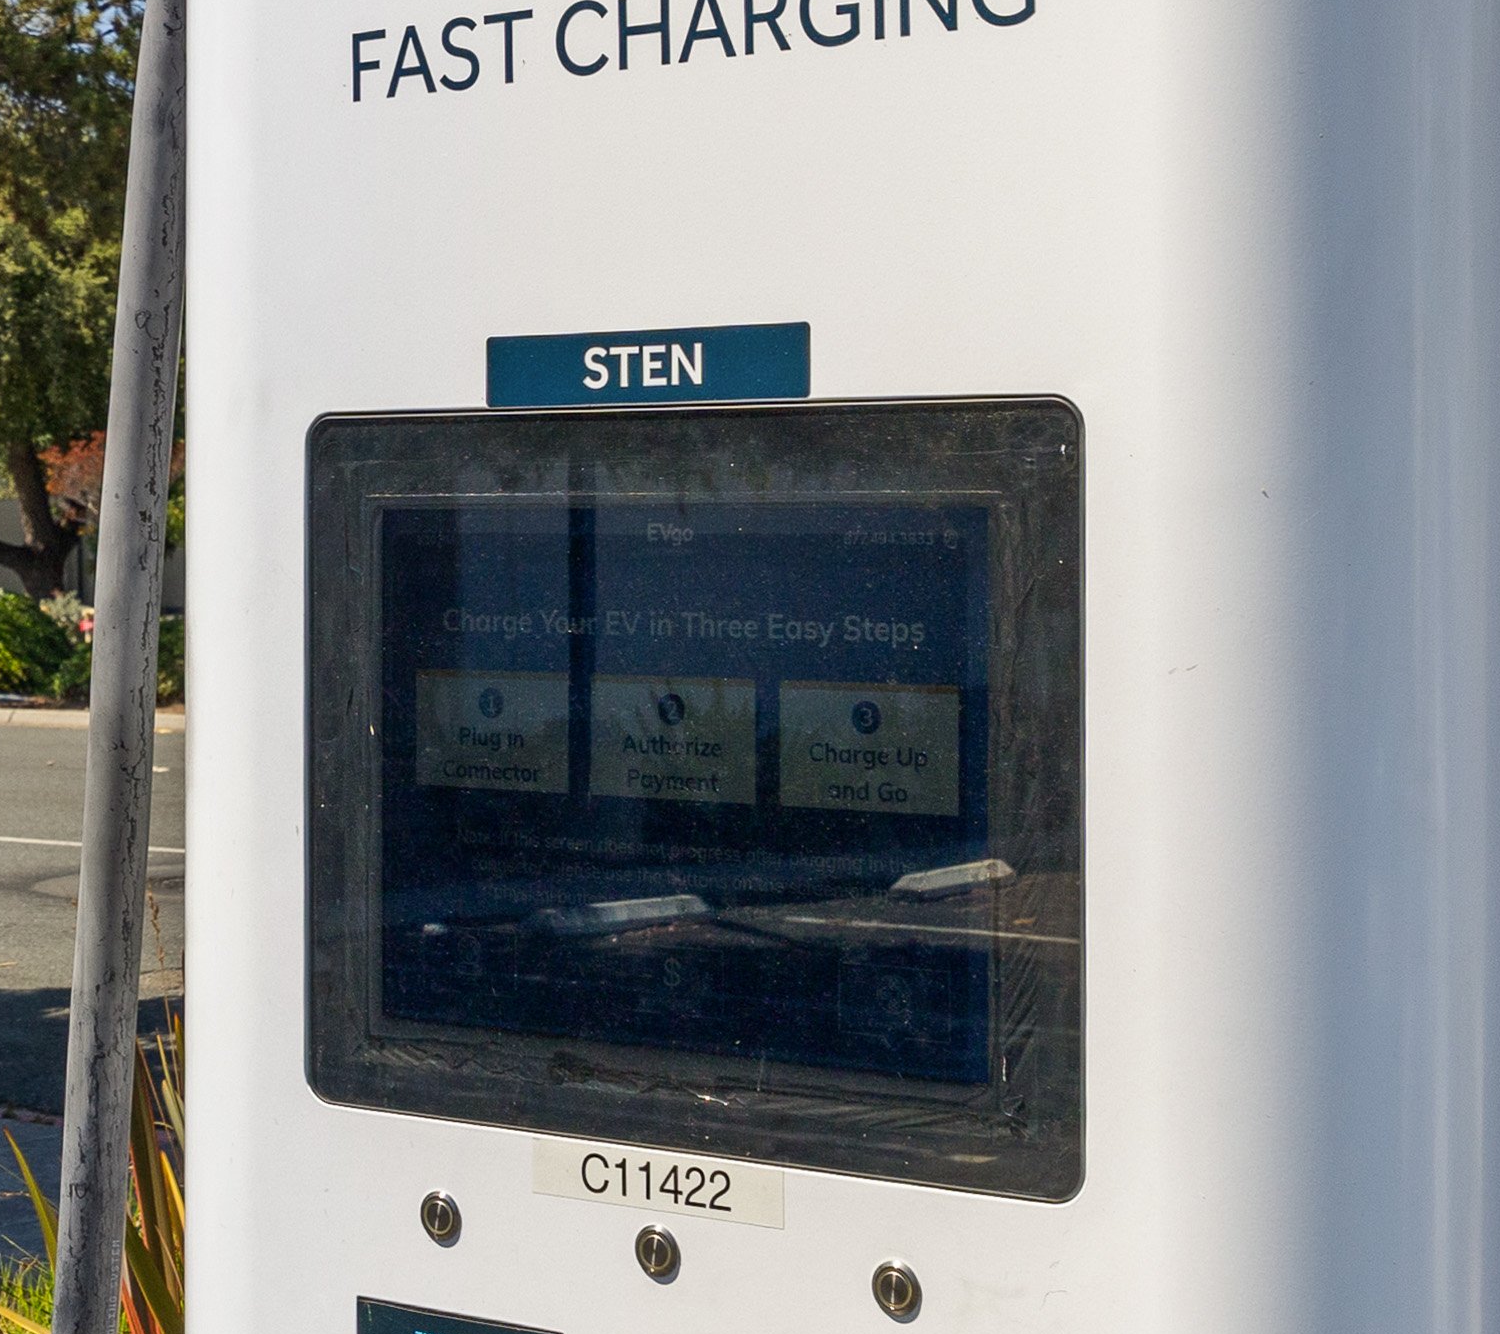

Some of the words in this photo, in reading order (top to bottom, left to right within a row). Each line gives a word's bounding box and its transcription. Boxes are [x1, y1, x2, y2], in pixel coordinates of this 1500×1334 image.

[351, 9, 533, 102] FAST
[582, 342, 704, 389] STEN
[647, 521, 693, 546] EVgo
[443, 606, 532, 640] Charge
[539, 609, 597, 636] Your
[606, 611, 641, 635] EV
[649, 610, 671, 636] in
[681, 611, 758, 638] Three
[767, 613, 834, 647] Easy
[843, 615, 925, 649] Steps
[860, 707, 873, 727] 3
[460, 727, 502, 751] Plug
[622, 735, 722, 758] Authorize
[809, 742, 889, 770] Charge
[897, 747, 928, 773] Up
[443, 759, 539, 782] Connector
[627, 769, 719, 794] Payment
[829, 780, 869, 801] and
[878, 782, 908, 803] Go
[581, 1153, 732, 1212] C11422
